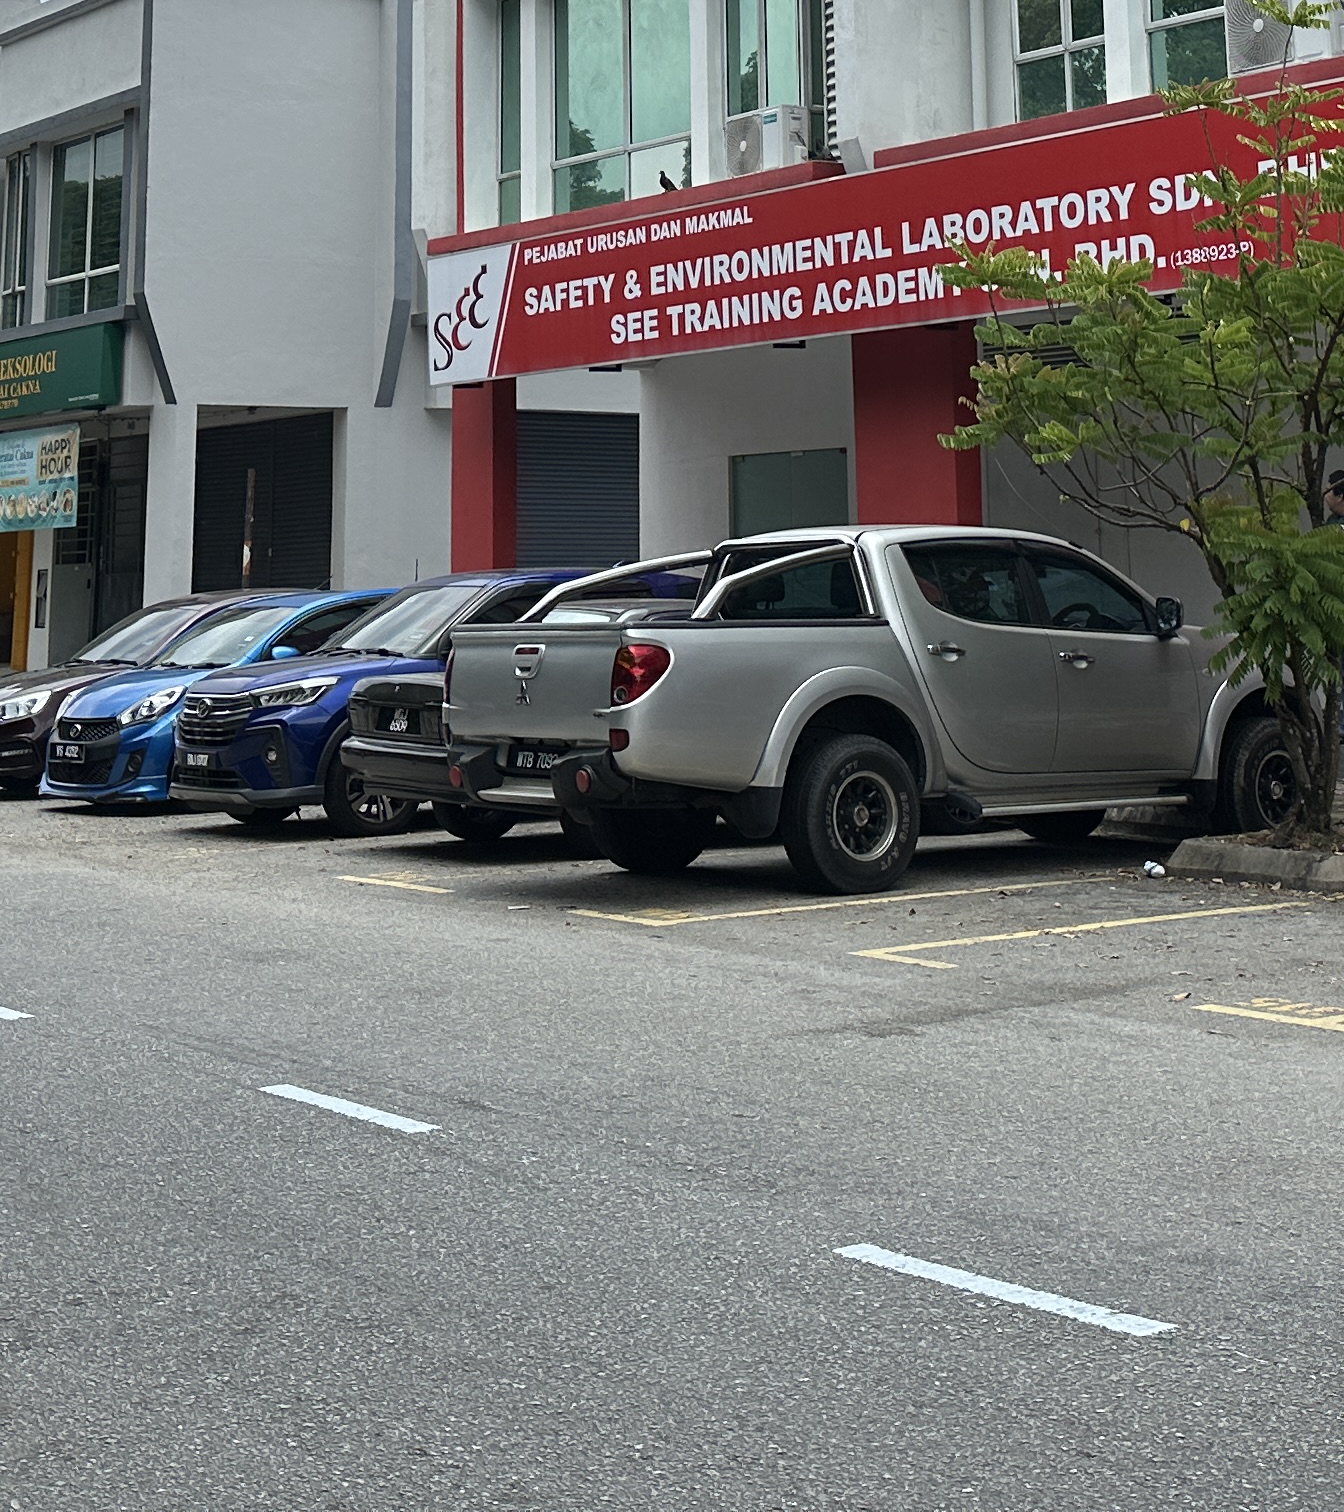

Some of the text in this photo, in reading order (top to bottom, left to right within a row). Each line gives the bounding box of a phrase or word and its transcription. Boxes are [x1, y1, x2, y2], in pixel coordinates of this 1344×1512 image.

[523, 206, 754, 266] PEJABAT URUSAN DAN MAKMAL
[523, 273, 616, 317] SAFETY
[623, 269, 642, 300] &
[650, 226, 893, 296] ENVIRONMENTAL
[901, 182, 1137, 255] LABORATORY
[610, 309, 660, 345] SEE
[666, 286, 803, 336] TRAINING
[40, 437, 73, 457] HAPPY
[40, 455, 72, 477] HOUR
[516, 751, 534, 767] WTB
